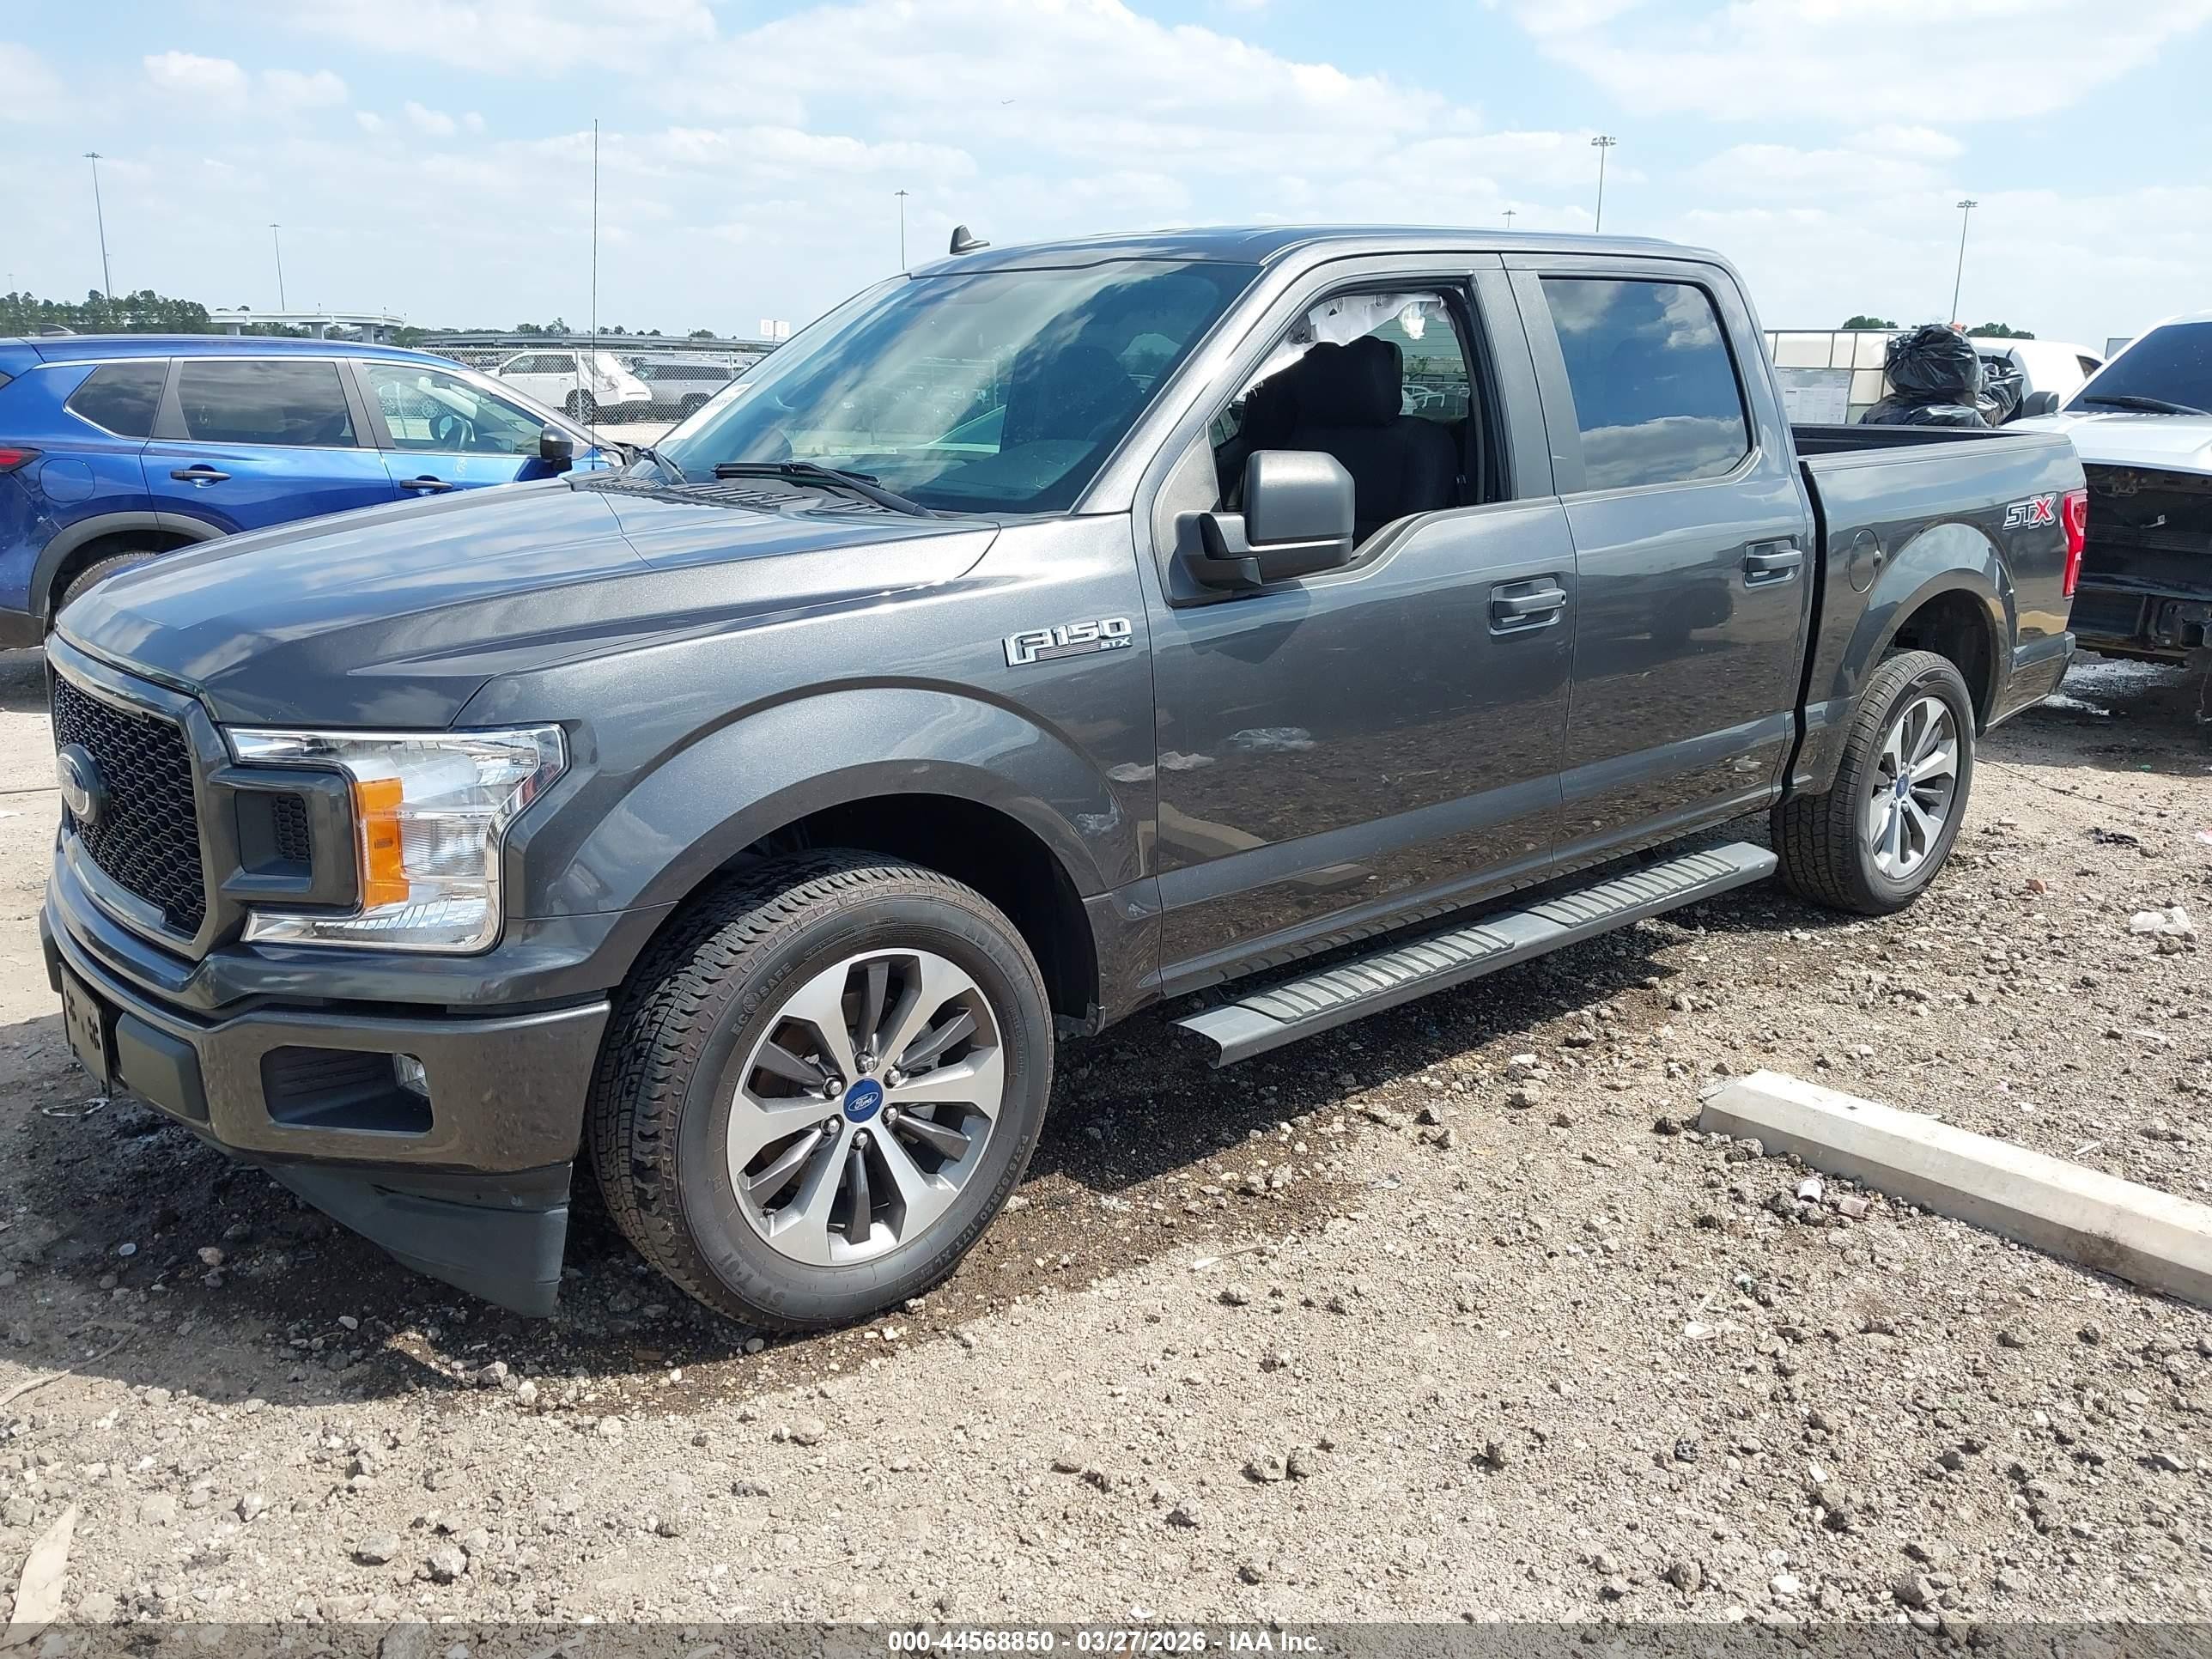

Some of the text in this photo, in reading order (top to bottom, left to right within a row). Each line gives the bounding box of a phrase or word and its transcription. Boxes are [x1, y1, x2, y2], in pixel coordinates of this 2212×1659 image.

[2003, 492, 2057, 530] STX
[1100, 636, 1132, 649] STX
[854, 1094, 873, 1109] Ford
